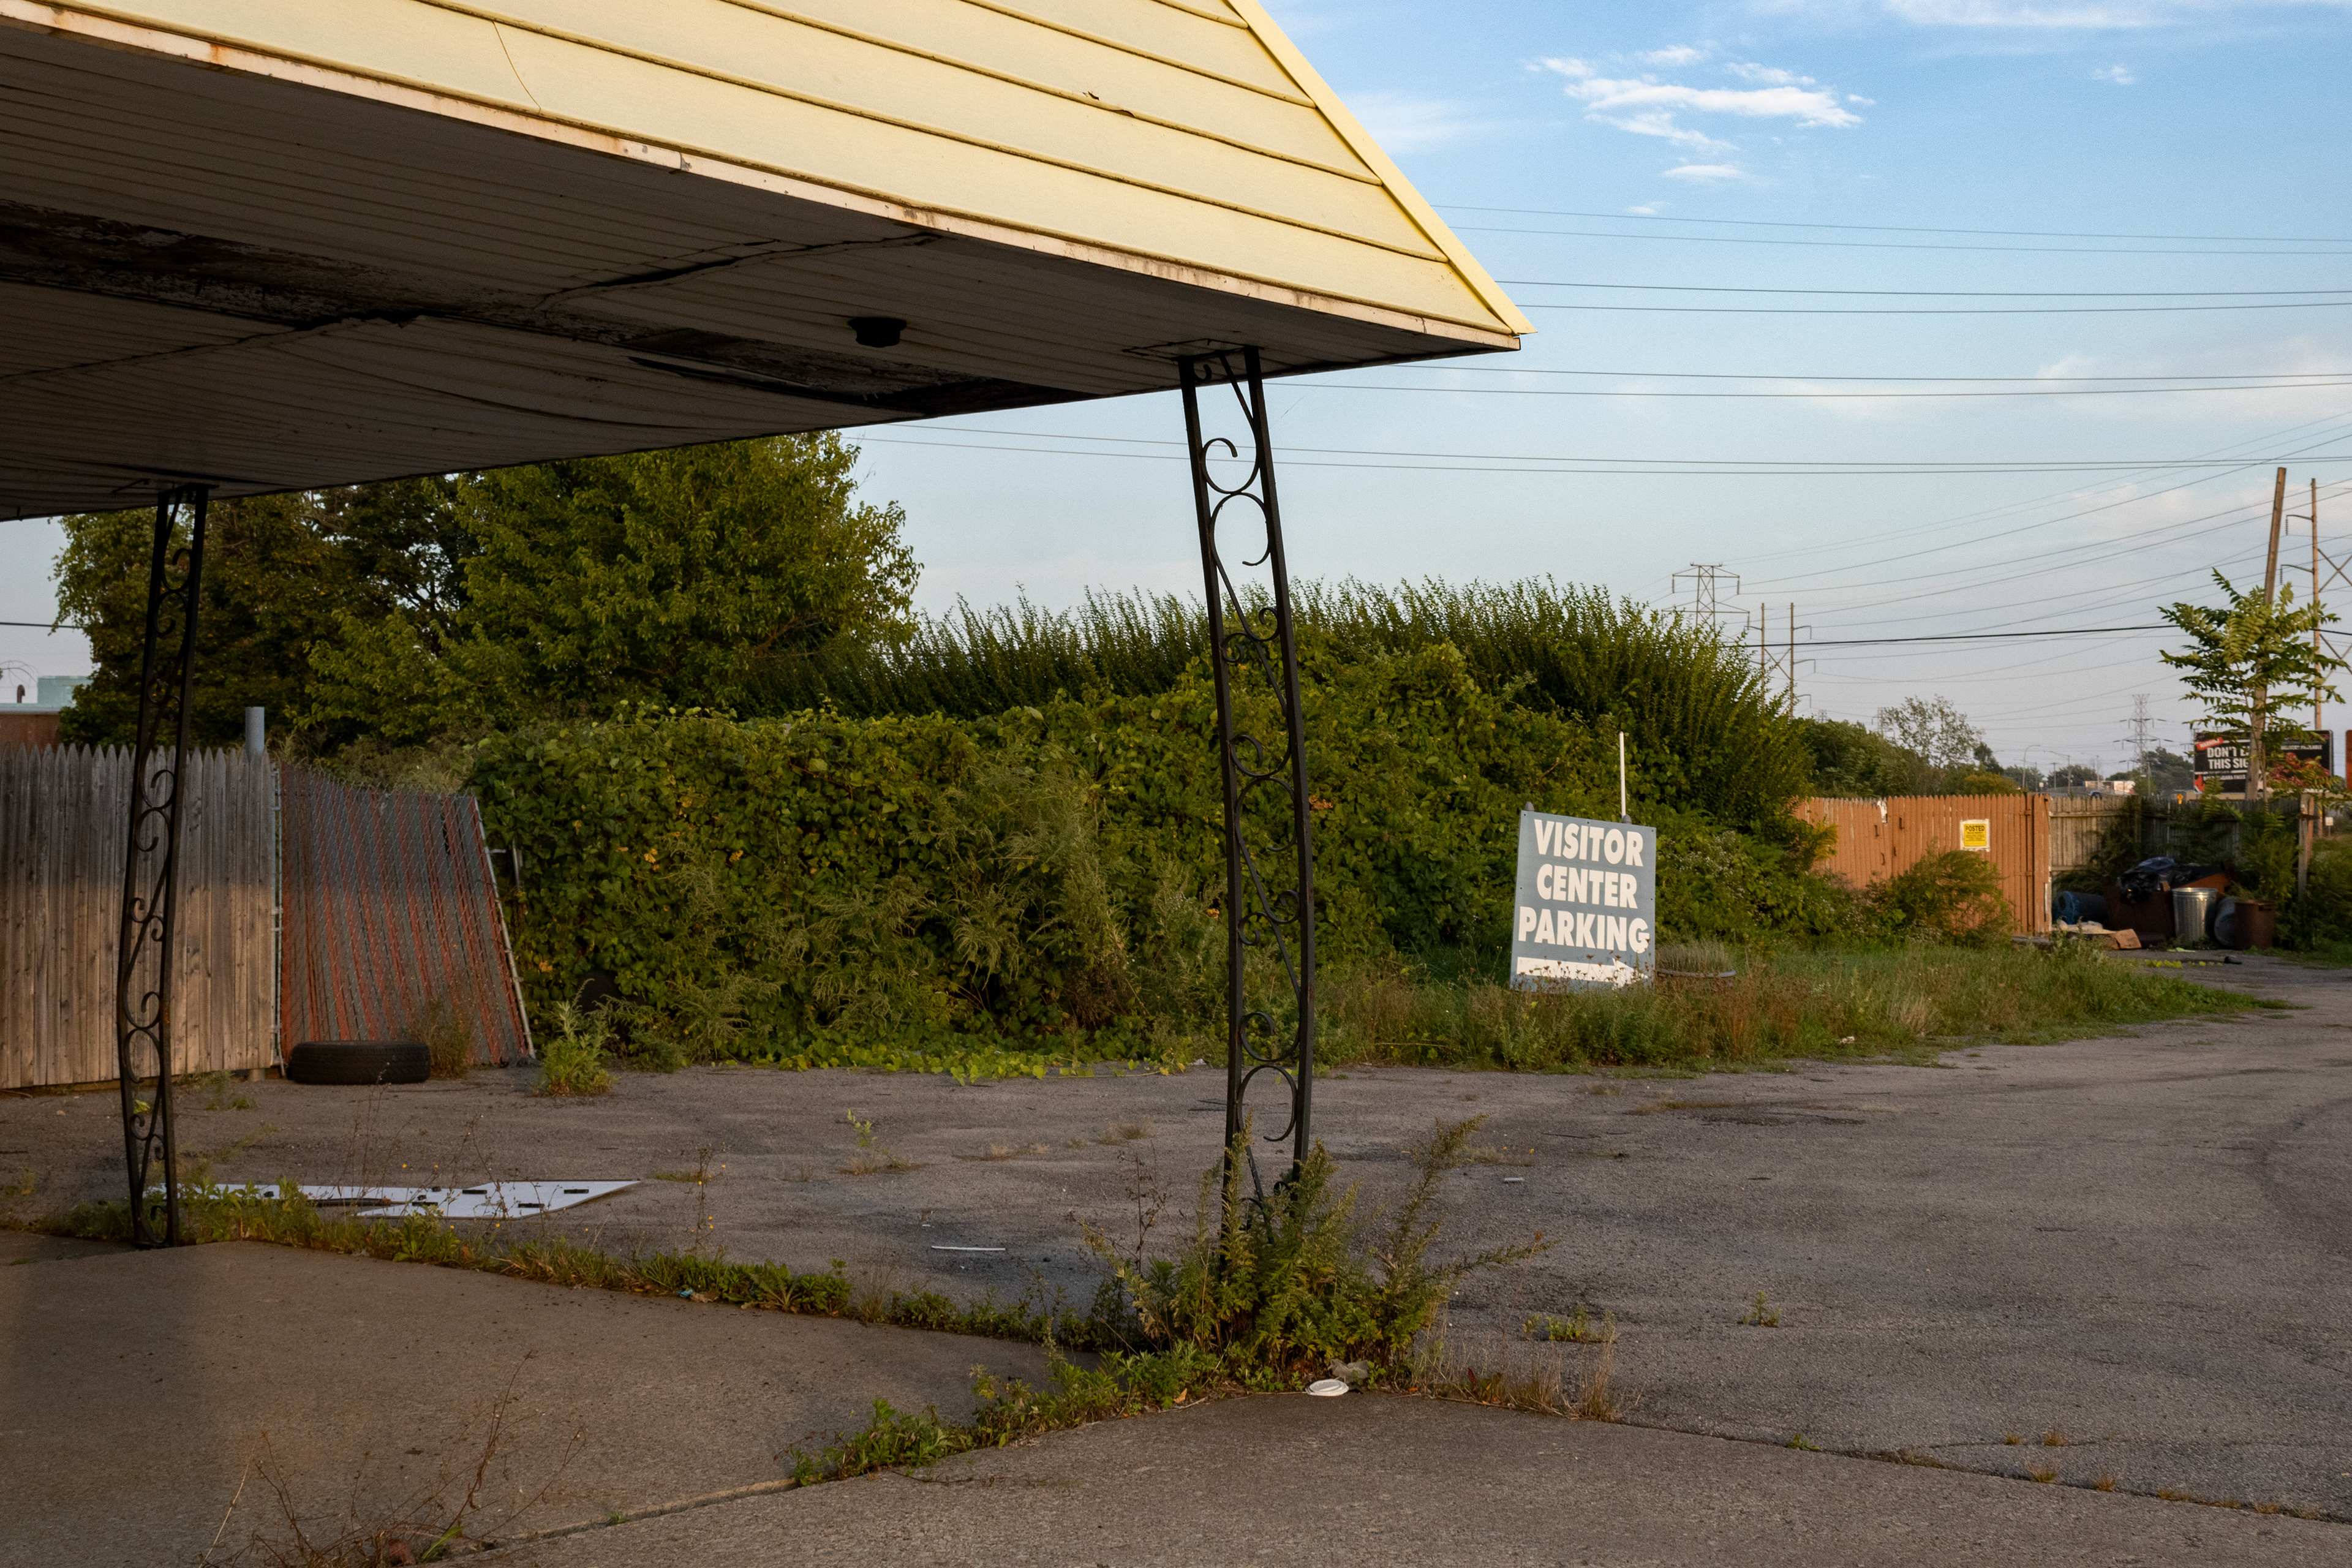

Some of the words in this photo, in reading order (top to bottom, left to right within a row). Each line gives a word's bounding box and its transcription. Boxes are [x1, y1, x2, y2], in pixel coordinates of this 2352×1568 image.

[2207, 746, 2237, 758] DON'T
[2208, 758, 2231, 769] THIS
[1534, 819, 1643, 867] VISITOR
[1537, 864, 1638, 909] CENTER
[1518, 906, 1650, 954] PARKING
